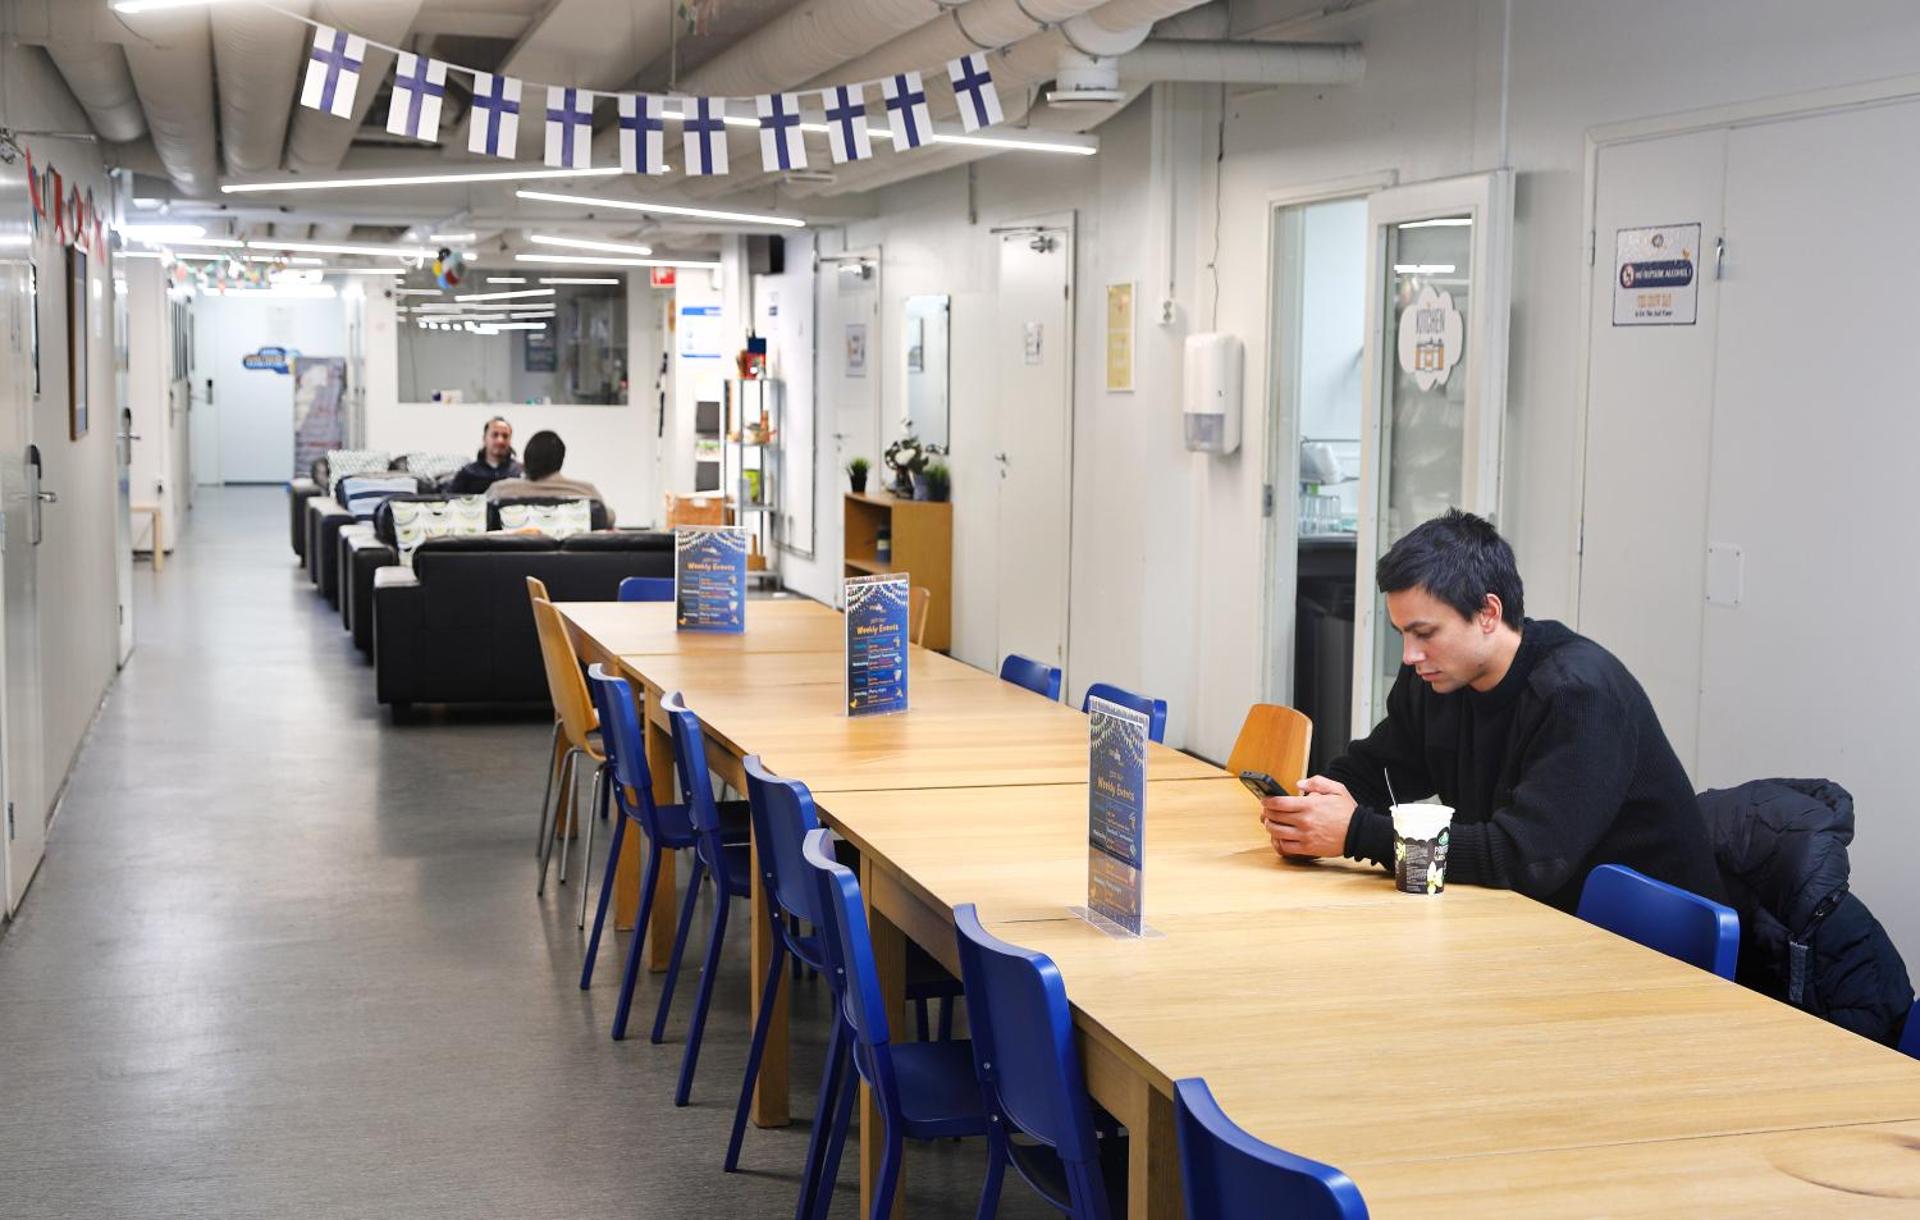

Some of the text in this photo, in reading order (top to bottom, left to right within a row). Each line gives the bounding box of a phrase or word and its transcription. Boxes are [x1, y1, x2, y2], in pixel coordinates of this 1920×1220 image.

[687, 563, 711, 572] Weekly
[856, 623, 899, 636] Weekly Events
[1097, 775, 1116, 796] Weekly
[1117, 781, 1135, 801] Events
